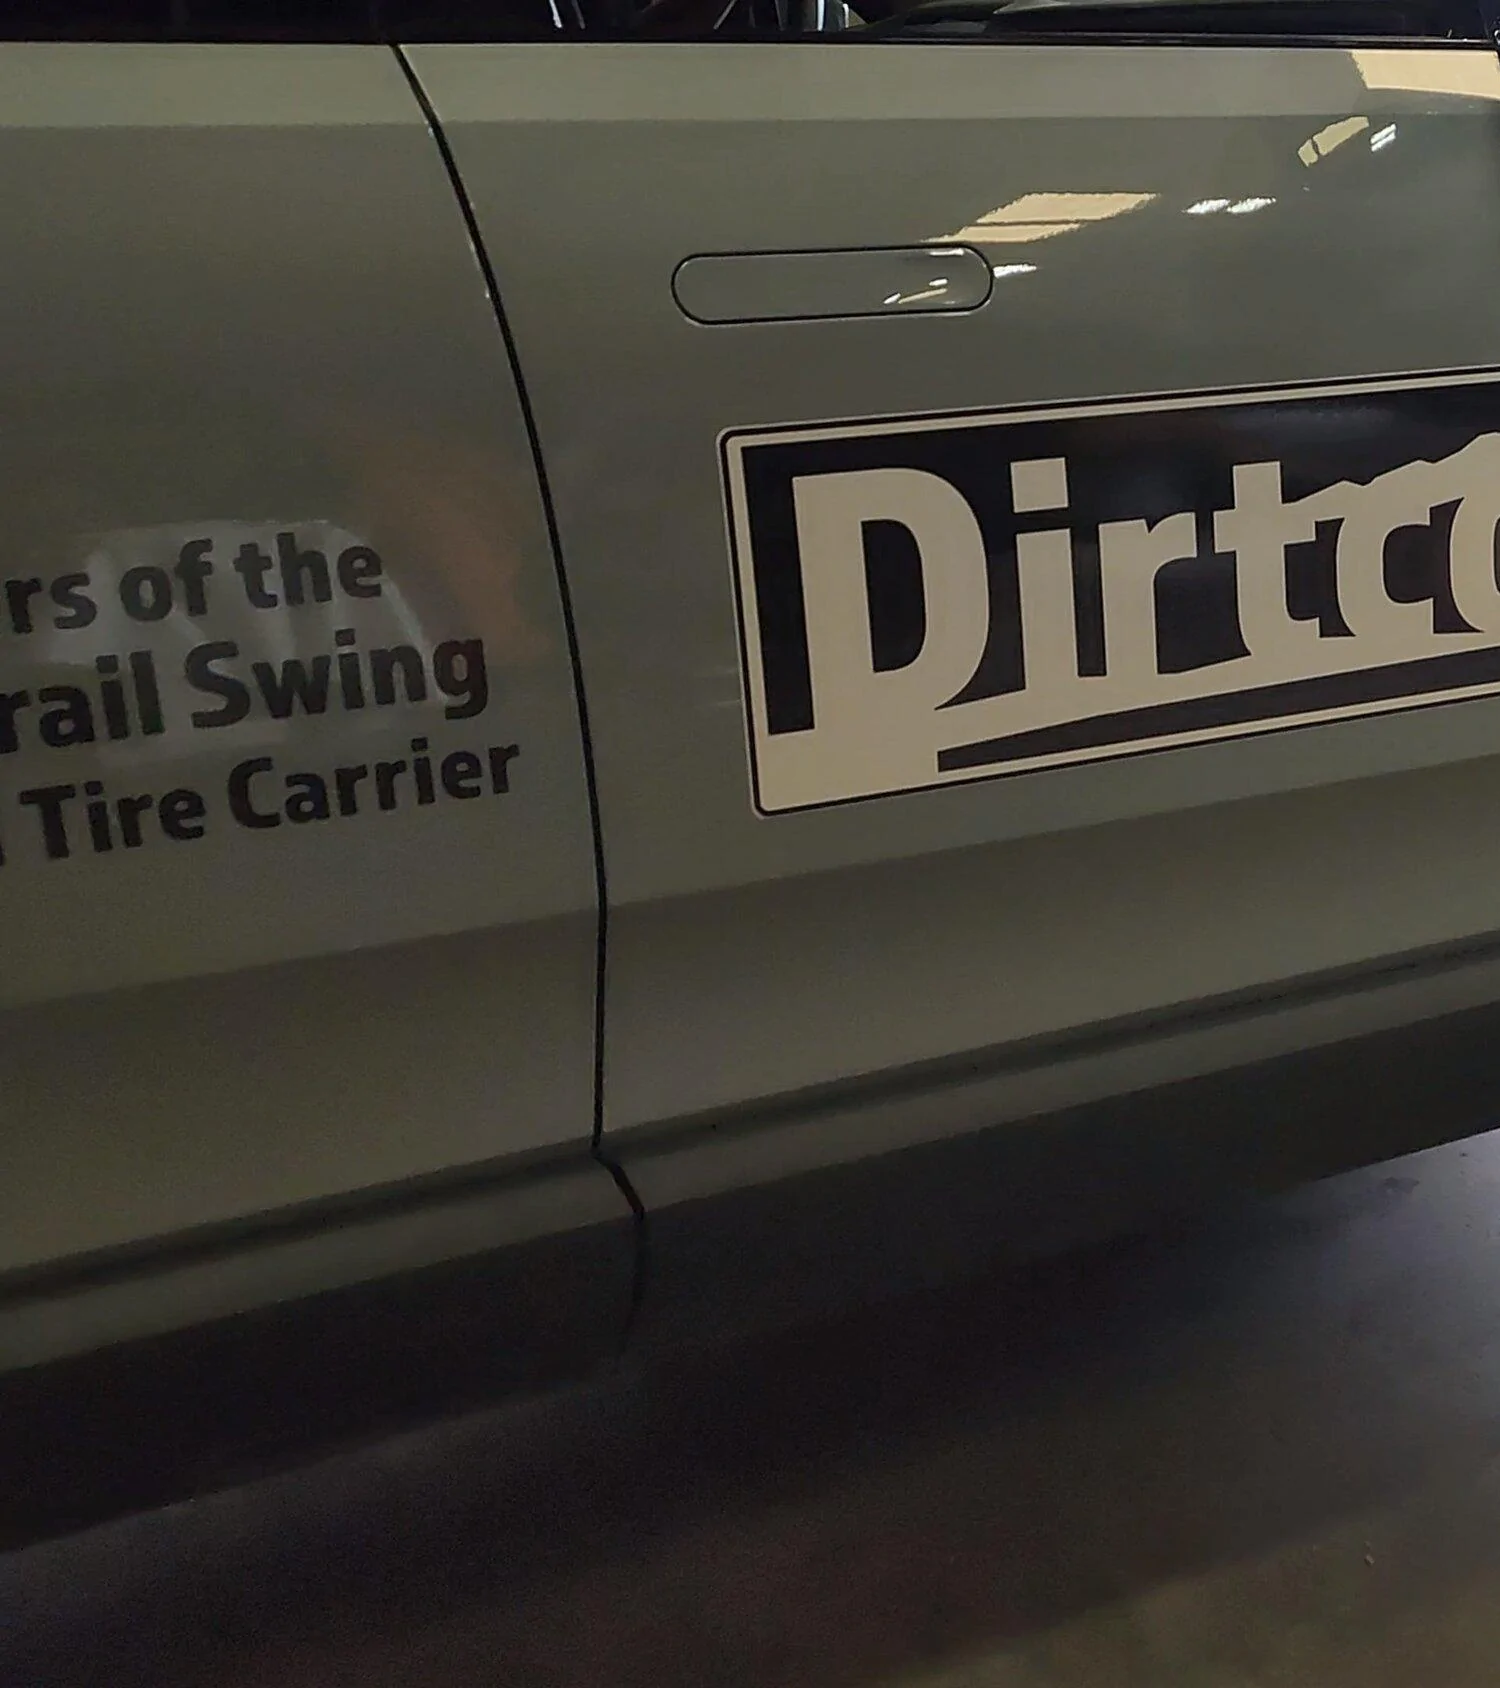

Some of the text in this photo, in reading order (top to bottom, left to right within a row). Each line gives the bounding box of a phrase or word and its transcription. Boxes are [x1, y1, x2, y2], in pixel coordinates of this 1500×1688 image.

[5, 532, 382, 634] rs of the
[184, 628, 489, 728] Swing
[20, 738, 519, 859] Tire Carrier
